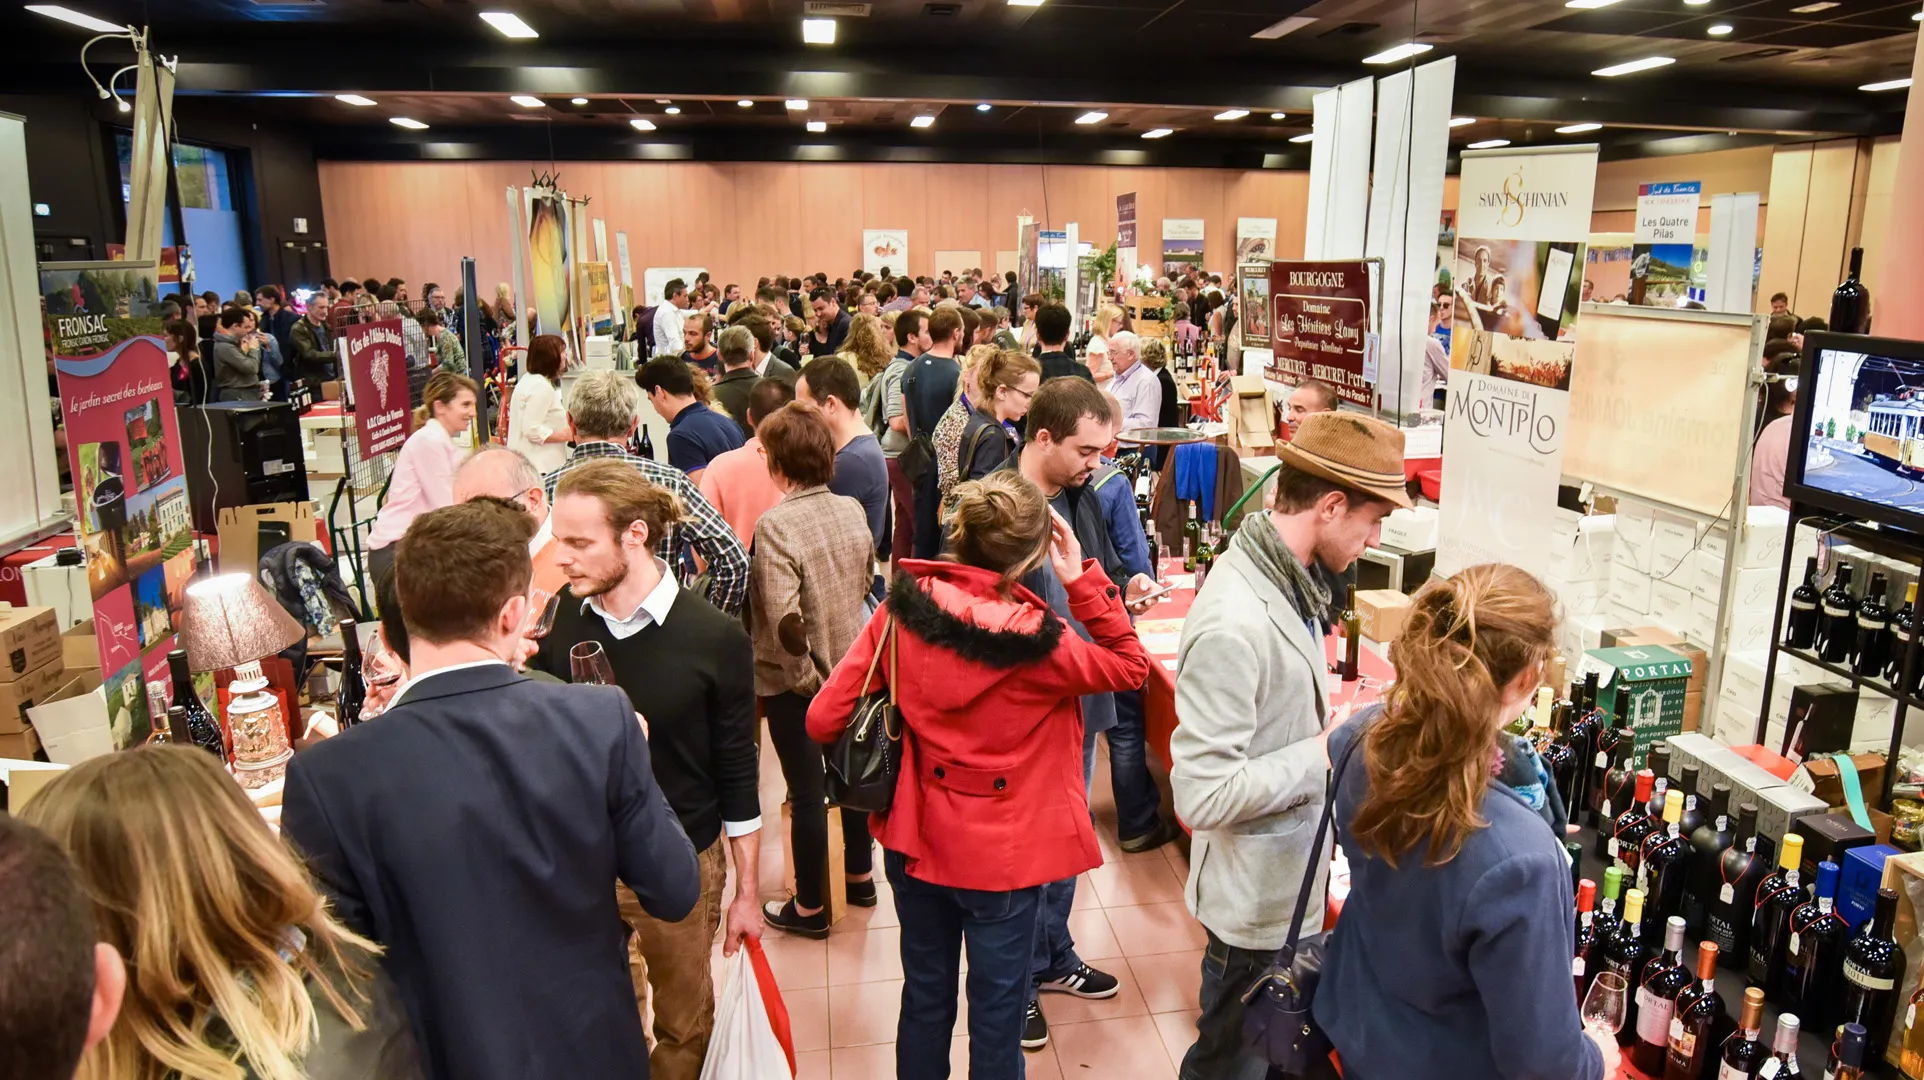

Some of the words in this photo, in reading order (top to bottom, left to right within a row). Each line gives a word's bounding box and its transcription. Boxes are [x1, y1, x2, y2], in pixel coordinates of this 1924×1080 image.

[1642, 217, 1657, 228] Les
[1659, 217, 1689, 227] Quatre
[1653, 229, 1675, 239] Pilas
[1289, 271, 1345, 289] BOURGOGNE
[1302, 300, 1331, 315] Domaine
[58, 314, 108, 338] FRONSAC
[1281, 313, 1295, 333] Les
[1297, 314, 1332, 337] Héritiers
[1334, 318, 1359, 346] Lamy
[351, 337, 362, 356] Clos
[362, 331, 370, 348] de
[369, 327, 385, 345] l'Abbé
[386, 328, 402, 347] Dubois
[1277, 356, 1307, 376] MERCUREY
[1312, 363, 1346, 385] MERCUREY
[70, 396, 78, 413] le
[78, 391, 101, 416] jardin
[102, 388, 122, 405] secret
[123, 382, 136, 399] des
[136, 378, 163, 395] bordeaux
[1337, 385, 1346, 397] Clos
[1346, 388, 1352, 399] du
[1450, 379, 1557, 455] MONTPLO
[1622, 662, 1692, 679] PORTAL
[1650, 729, 1680, 738] PORTUGAL
[1604, 954, 1631, 973] PORTAL
[1846, 956, 1872, 978] PORTAL
[1846, 968, 1865, 983] 2011
[1643, 993, 1669, 1010] ORTAL
